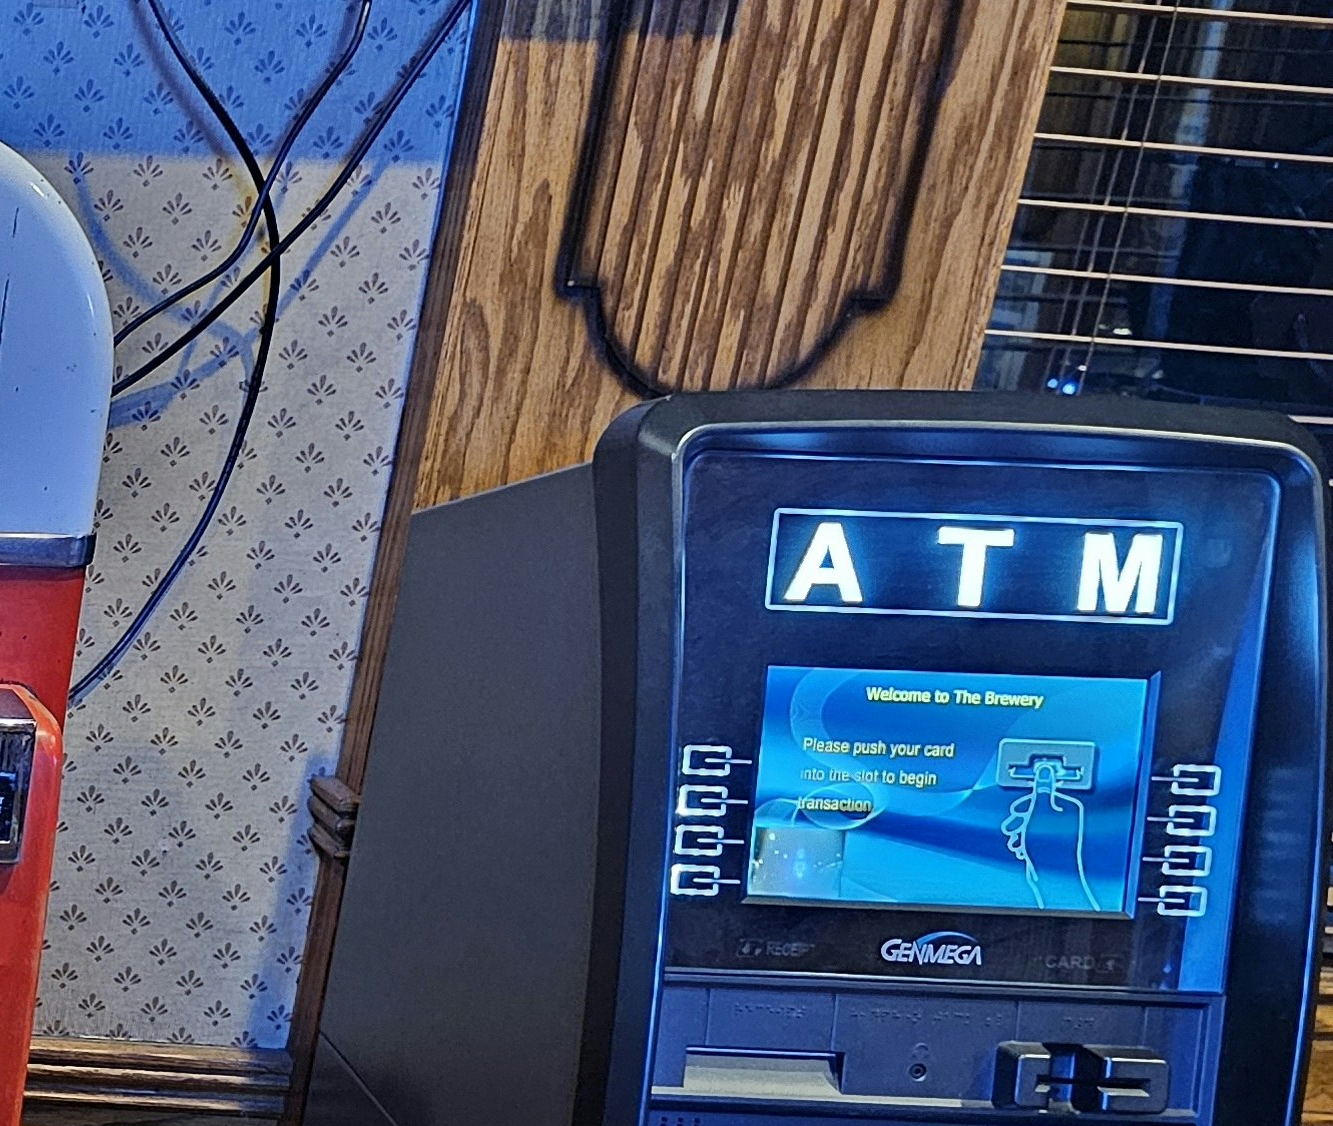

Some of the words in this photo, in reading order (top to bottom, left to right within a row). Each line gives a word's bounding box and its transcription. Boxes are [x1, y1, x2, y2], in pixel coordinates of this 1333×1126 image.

[783, 522, 1164, 614] ATM
[866, 687, 931, 703] Welcome
[934, 689, 949, 704] to
[953, 690, 982, 705] The
[985, 691, 1044, 709] Brewery
[803, 737, 850, 753] Please
[853, 740, 886, 756] push
[889, 743, 920, 758] your
[923, 743, 955, 758] card
[829, 769, 851, 782] the
[854, 769, 880, 783] slot
[882, 770, 896, 784] to
[899, 770, 937, 788] begin
[881, 937, 982, 966] GENMEGA
[1045, 955, 1093, 970] CARD
